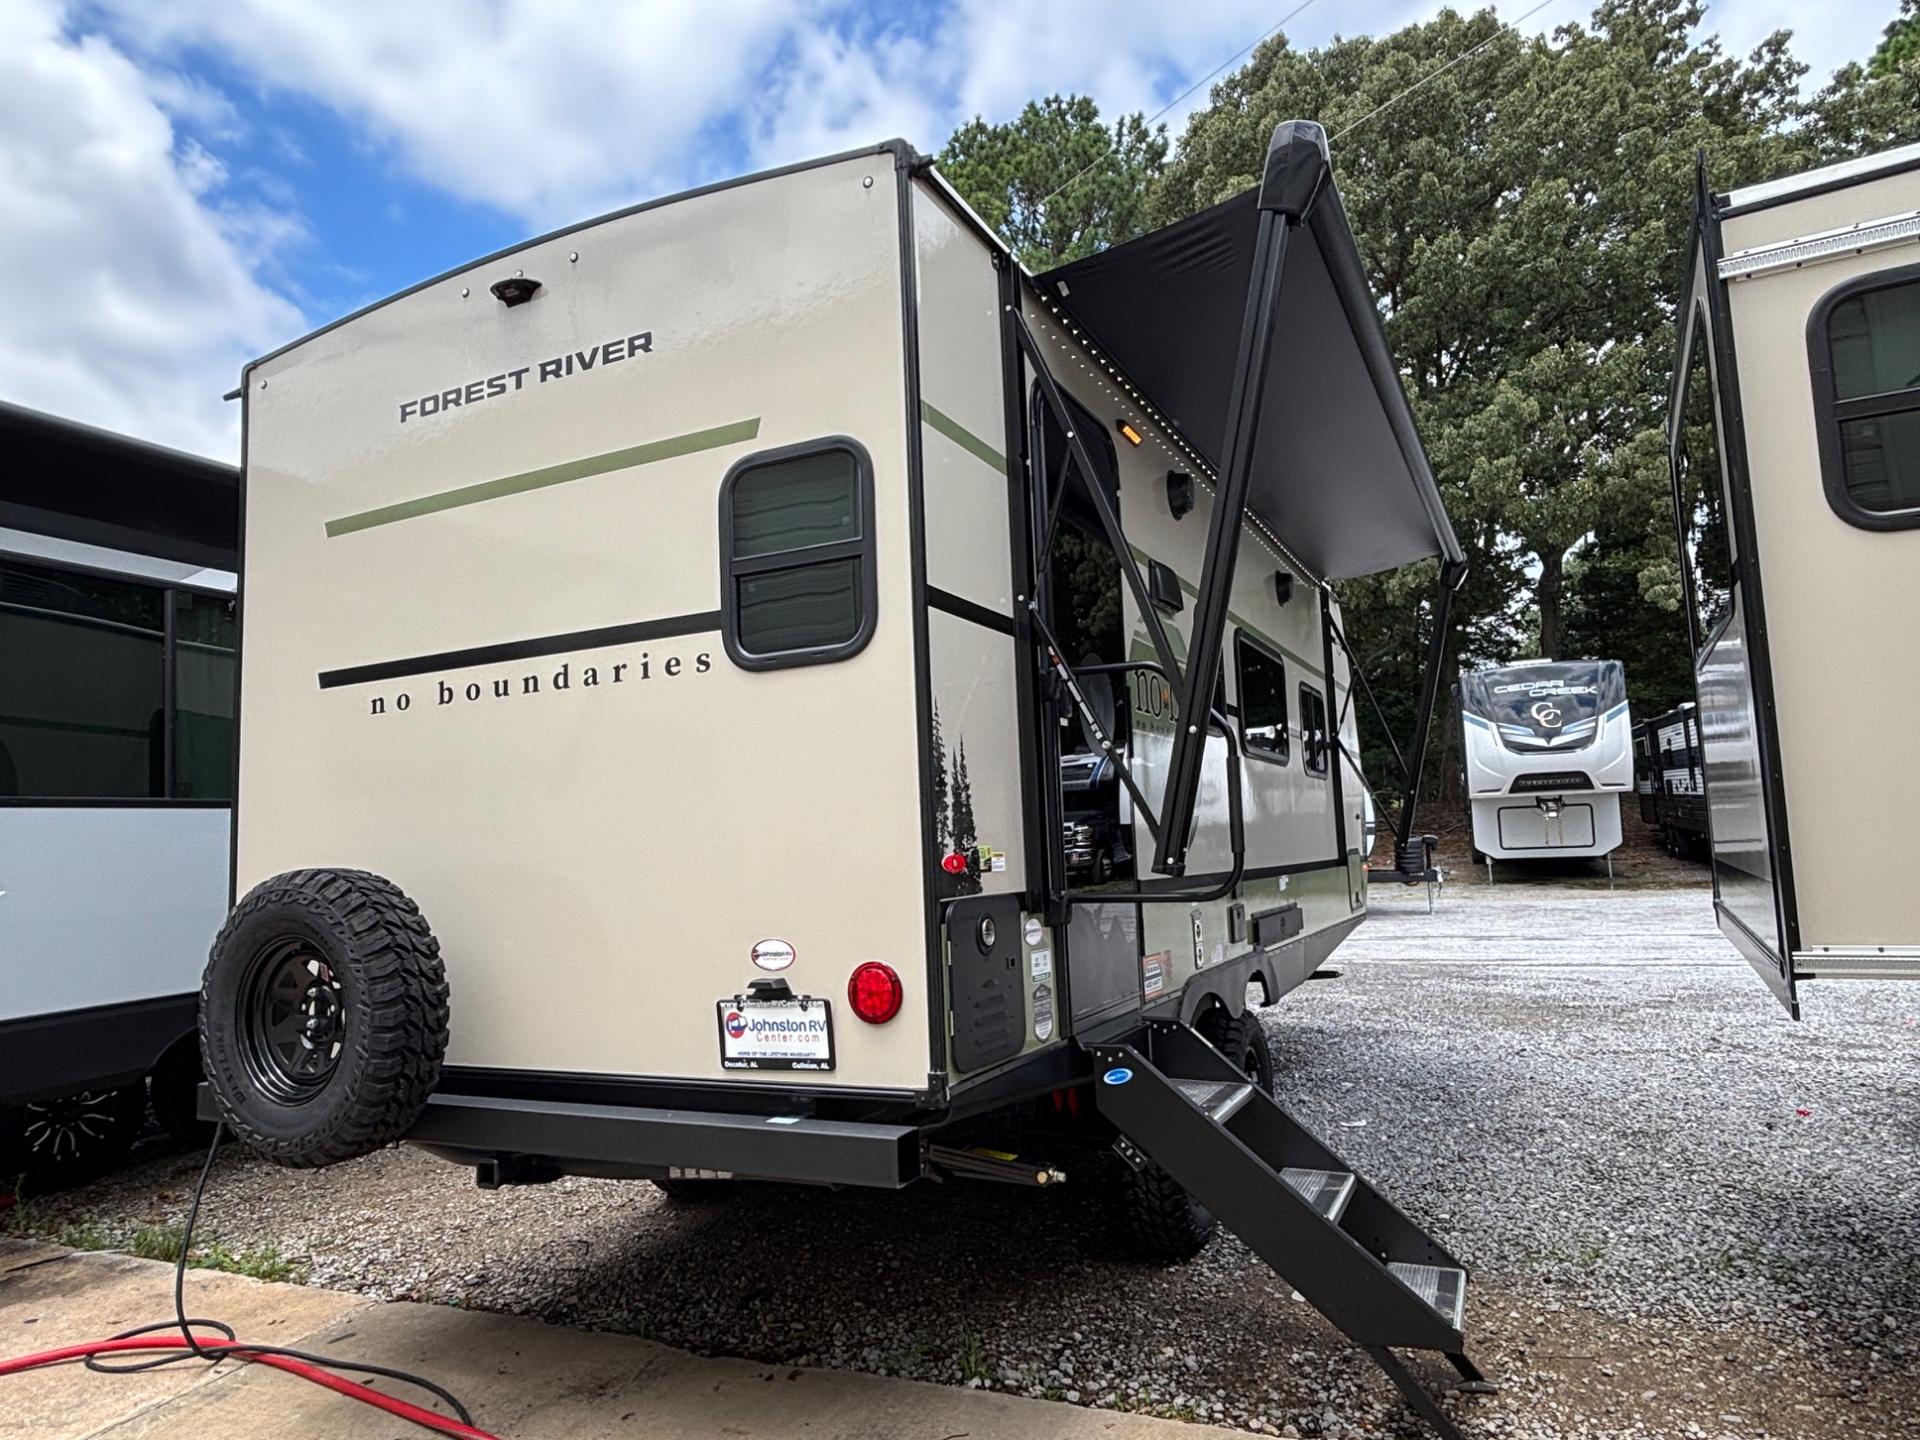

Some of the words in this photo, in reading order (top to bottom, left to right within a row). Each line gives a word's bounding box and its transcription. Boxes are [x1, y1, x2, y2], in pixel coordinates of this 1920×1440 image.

[399, 367, 530, 423] FOREST
[539, 331, 653, 383] RIVER
[370, 693, 411, 715] no
[437, 653, 711, 705] boundaries
[1494, 680, 1564, 694] CEDAR
[1529, 686, 1598, 697] CREEK
[748, 1018, 807, 1032] Johnston
[808, 1020, 826, 1032] RV
